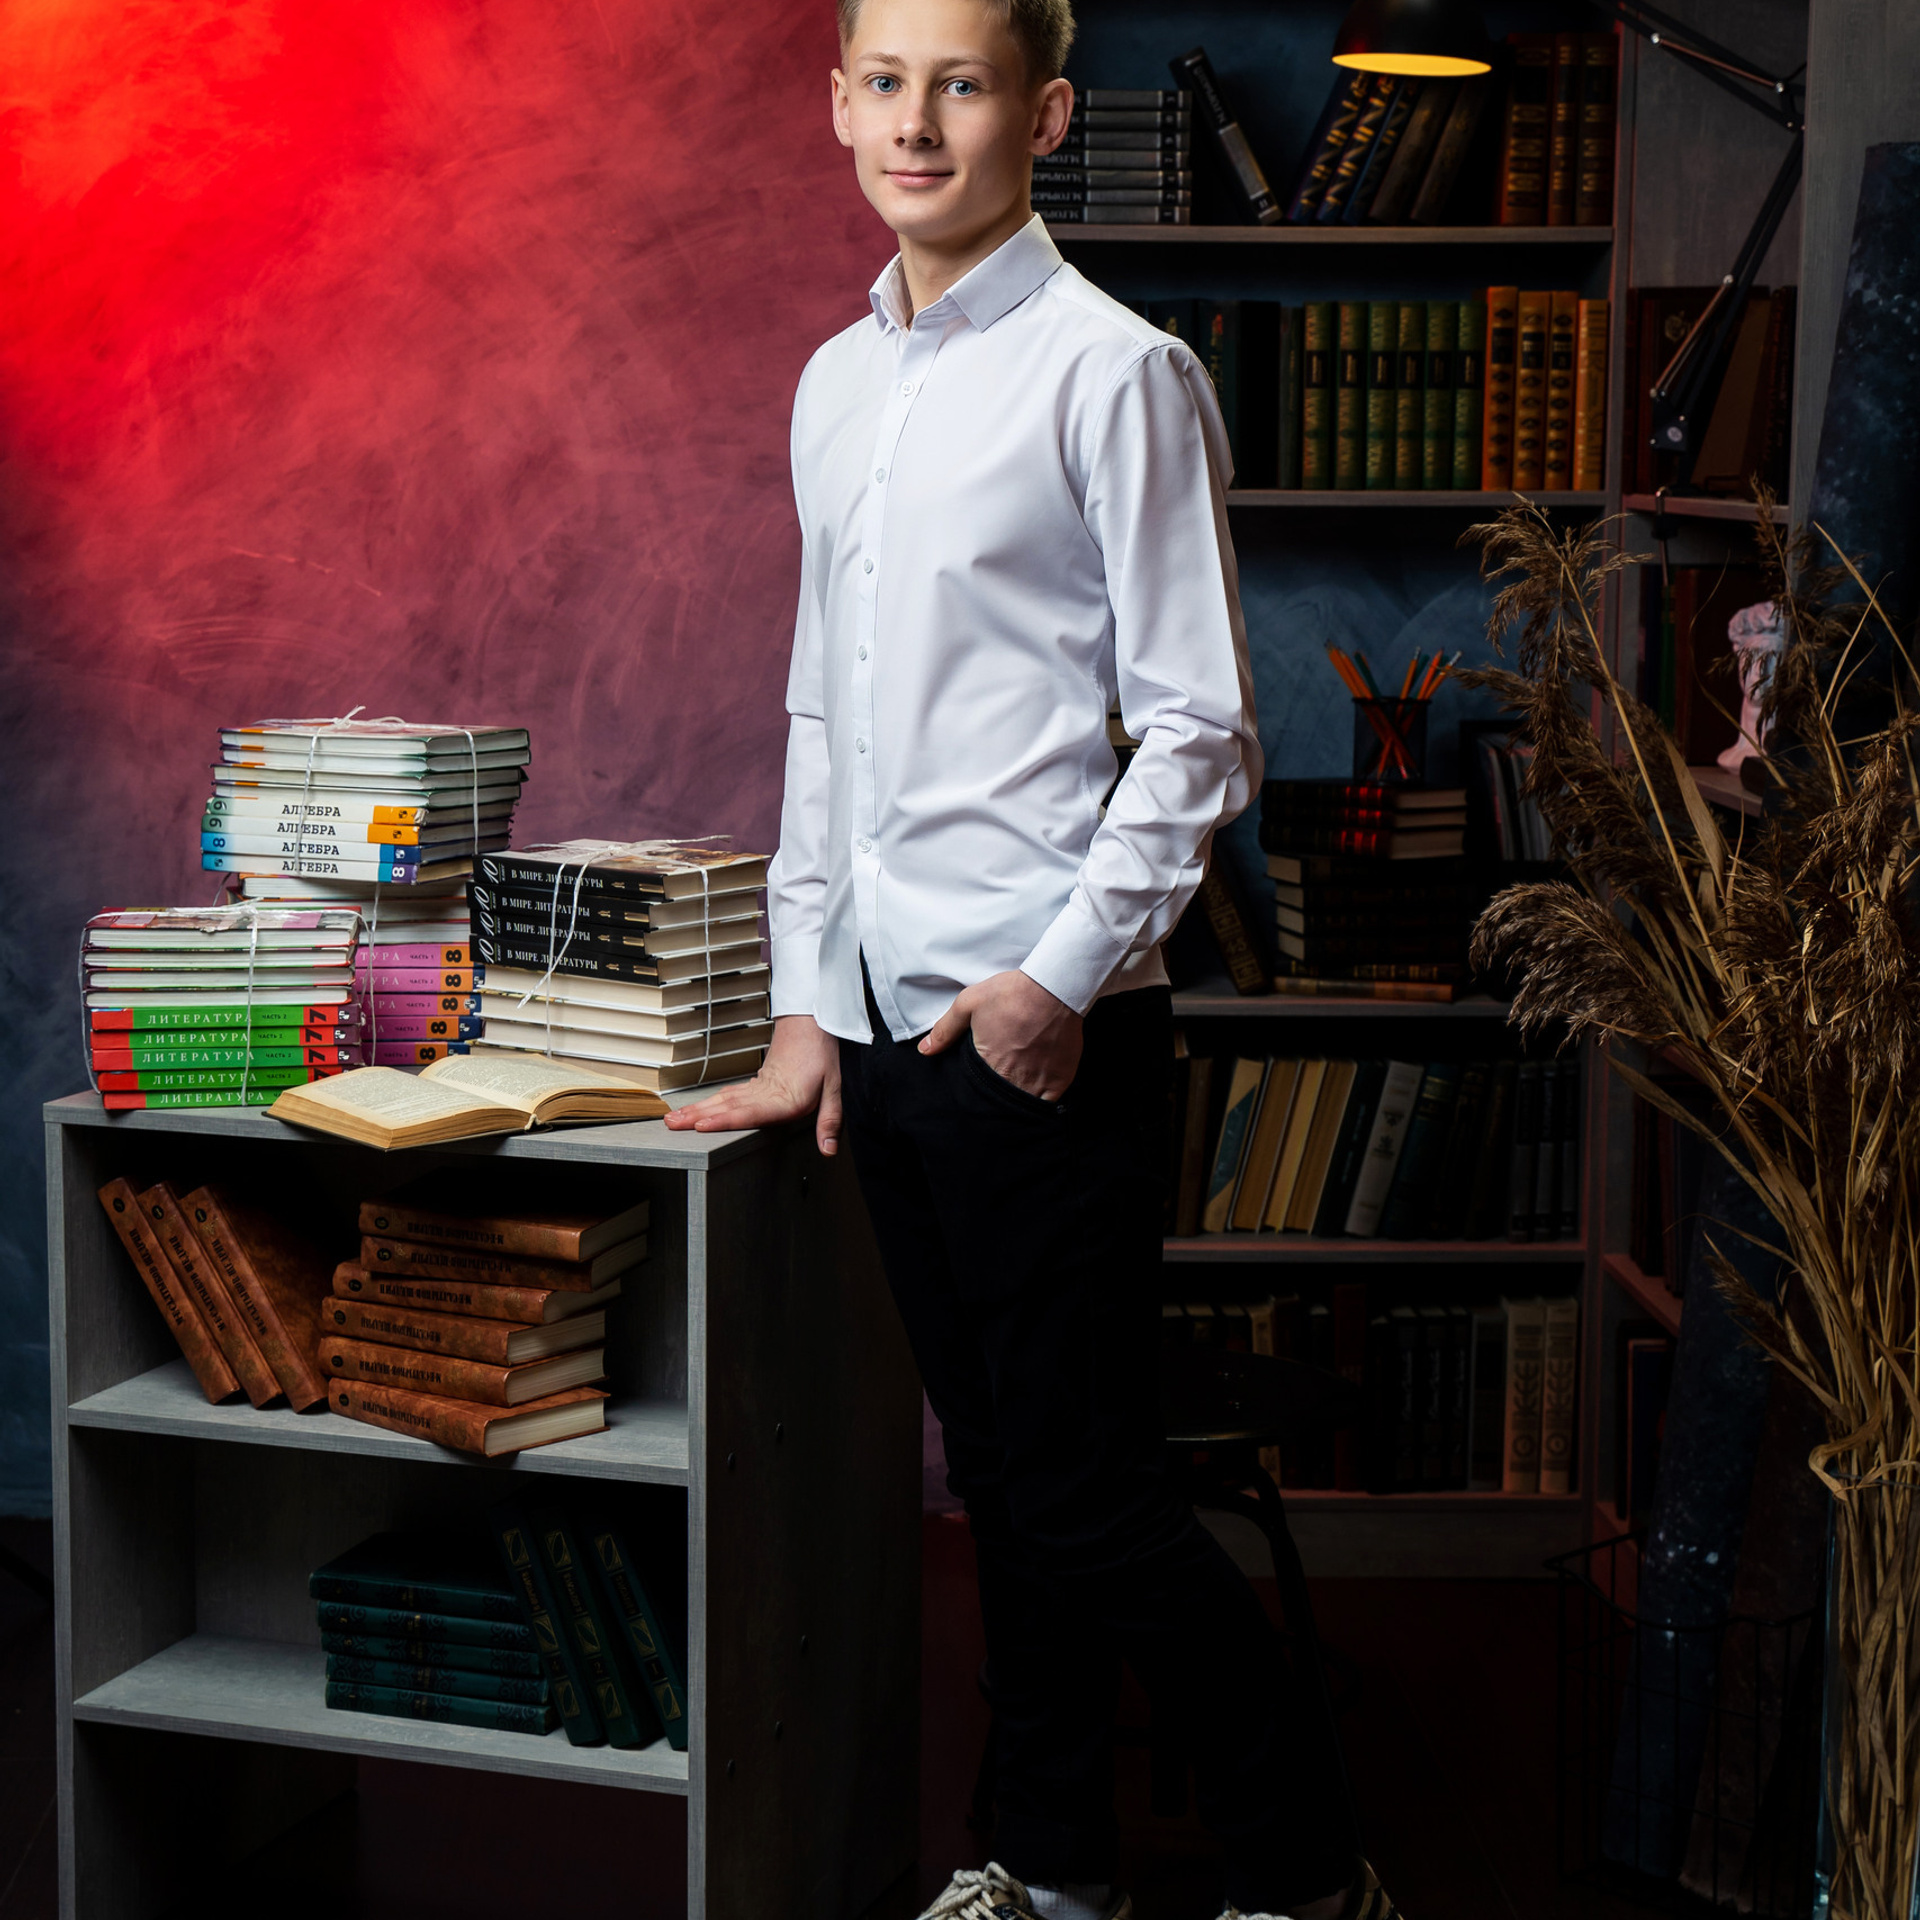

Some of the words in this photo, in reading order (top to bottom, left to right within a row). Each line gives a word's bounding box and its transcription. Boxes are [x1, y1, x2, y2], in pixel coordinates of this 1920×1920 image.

[212, 838, 226, 848] 8
[392, 867, 406, 878] 8
[511, 869, 518, 878] В
[520, 870, 543, 881] МИРЕ
[502, 897, 508, 906] В
[510, 898, 533, 909] МИРЕ
[534, 901, 590, 917] ЛИТРАТРЫ
[506, 921, 512, 931] В
[513, 922, 535, 933] МИРЕ
[445, 949, 462, 963] 8
[507, 949, 513, 959] В
[515, 950, 539, 962] МИРЕ
[445, 974, 462, 988] 8
[442, 997, 459, 1011] 8
[148, 1011, 252, 1024] ЛИТЕРАТУРА
[310, 1009, 327, 1023] 7
[430, 1021, 447, 1034] 8
[143, 1031, 249, 1044] ЛИТЕРАТУРА
[305, 1027, 322, 1042] 7
[142, 1051, 255, 1063] ЛИТЕРАТУРА
[308, 1049, 326, 1063] 7
[419, 1047, 436, 1060] 8
[153, 1072, 257, 1085] ЛИТЕРАТУРА
[161, 1091, 264, 1104] ЛИТЕРАТУРА
